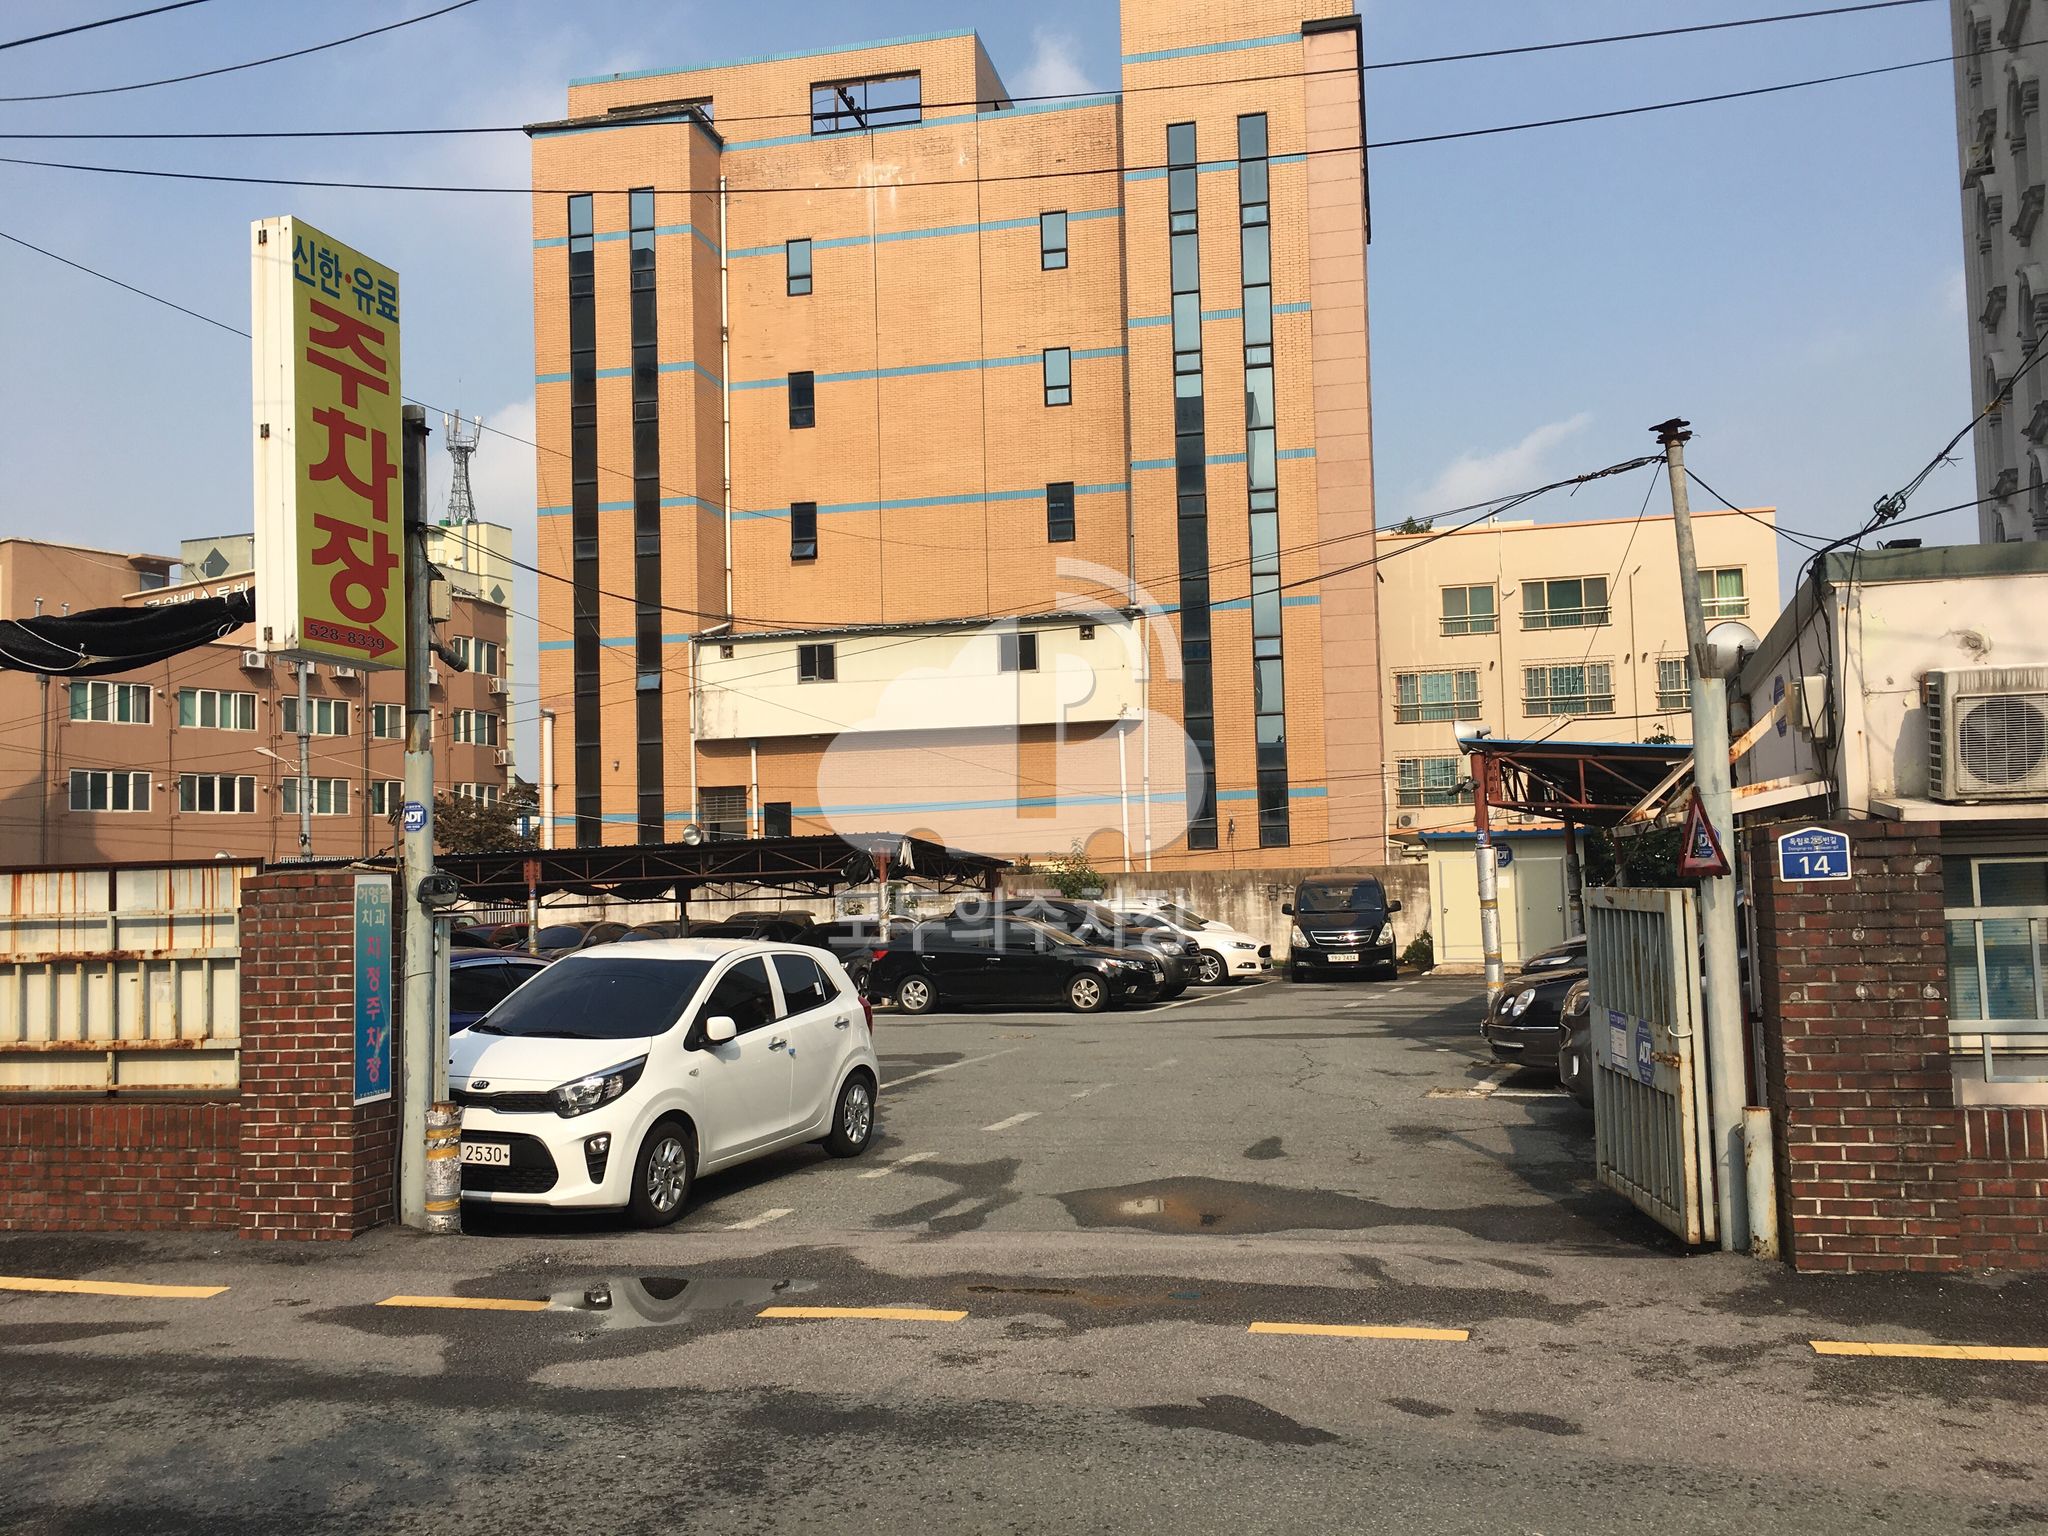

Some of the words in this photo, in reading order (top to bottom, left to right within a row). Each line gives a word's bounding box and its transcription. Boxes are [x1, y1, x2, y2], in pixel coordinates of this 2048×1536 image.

[306, 297, 399, 624] 주차장
[308, 623, 385, 650] 528-8339
[1799, 855, 1831, 875] 14
[361, 908, 386, 927] 치과
[465, 1145, 502, 1162] 2530
